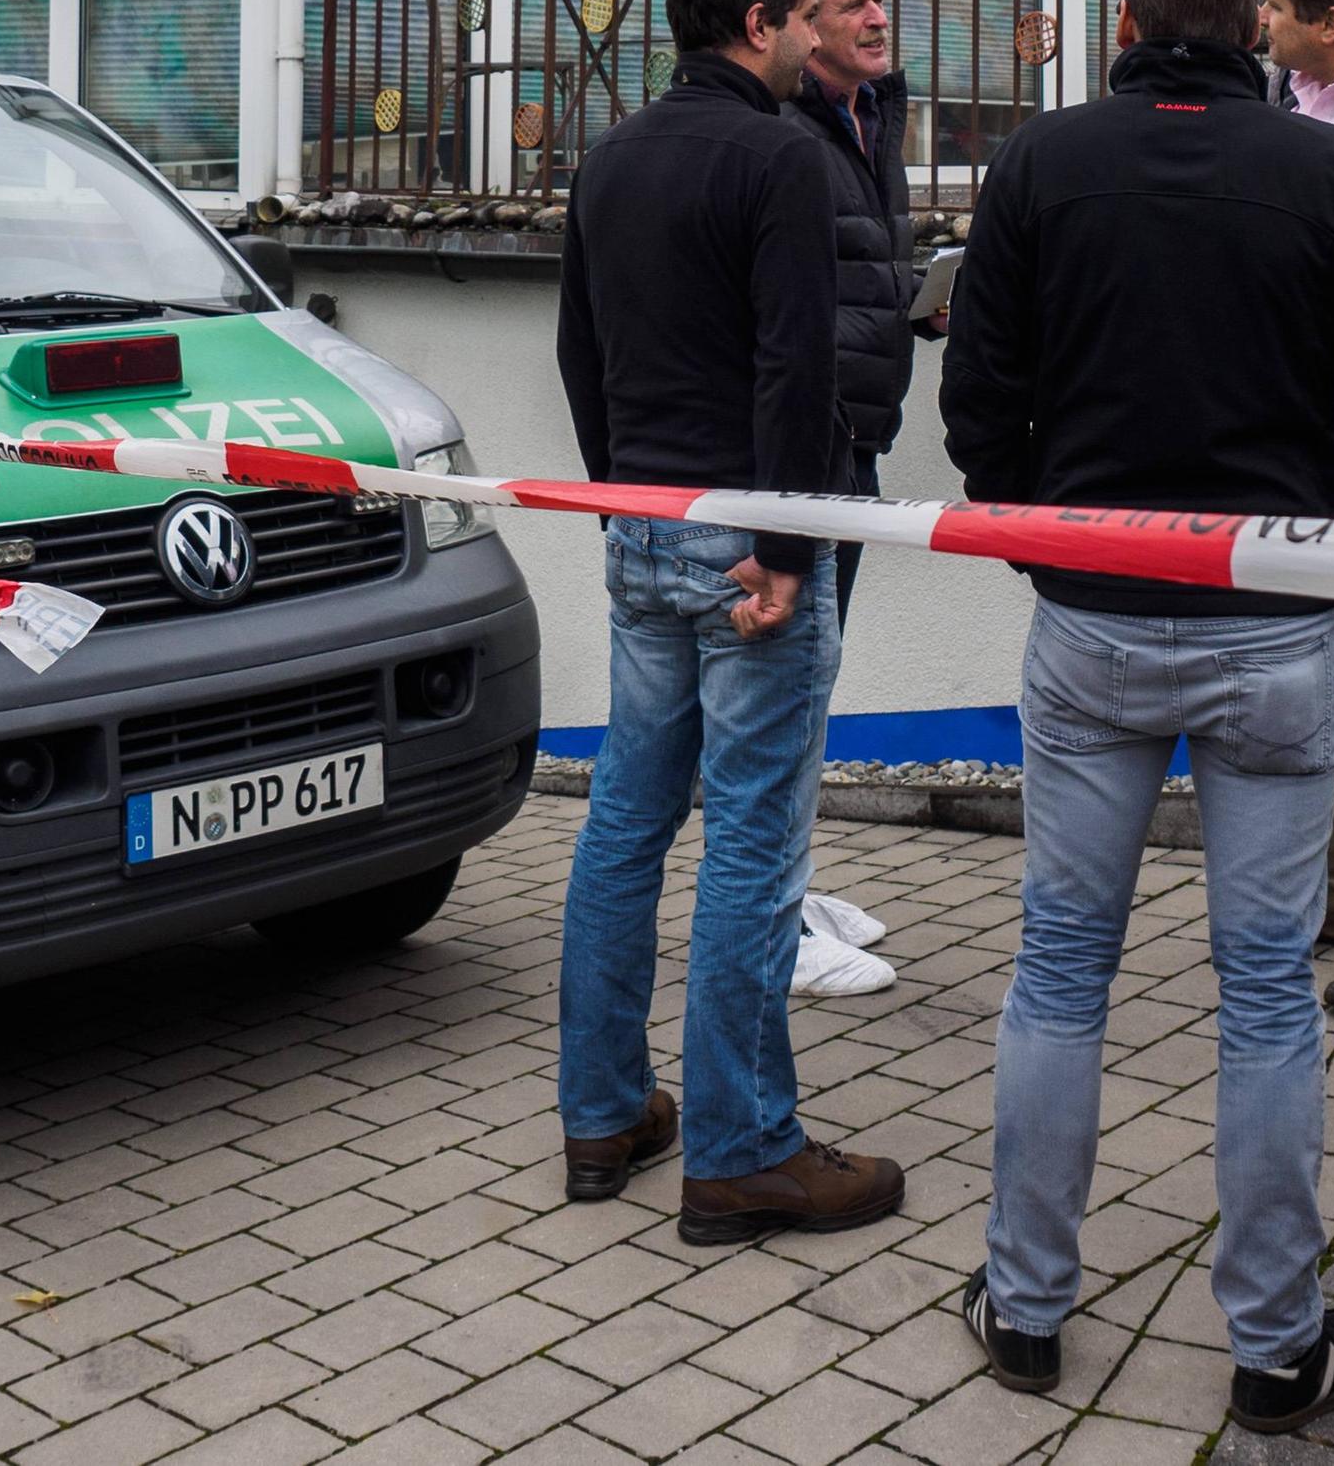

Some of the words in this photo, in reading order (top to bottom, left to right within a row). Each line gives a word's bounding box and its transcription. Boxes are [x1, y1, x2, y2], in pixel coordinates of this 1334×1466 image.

[1155, 103, 1207, 112] MAMMUT
[172, 791, 200, 846] N
[230, 774, 284, 833] PP
[295, 753, 366, 817] 617
[135, 836, 145, 851] D
